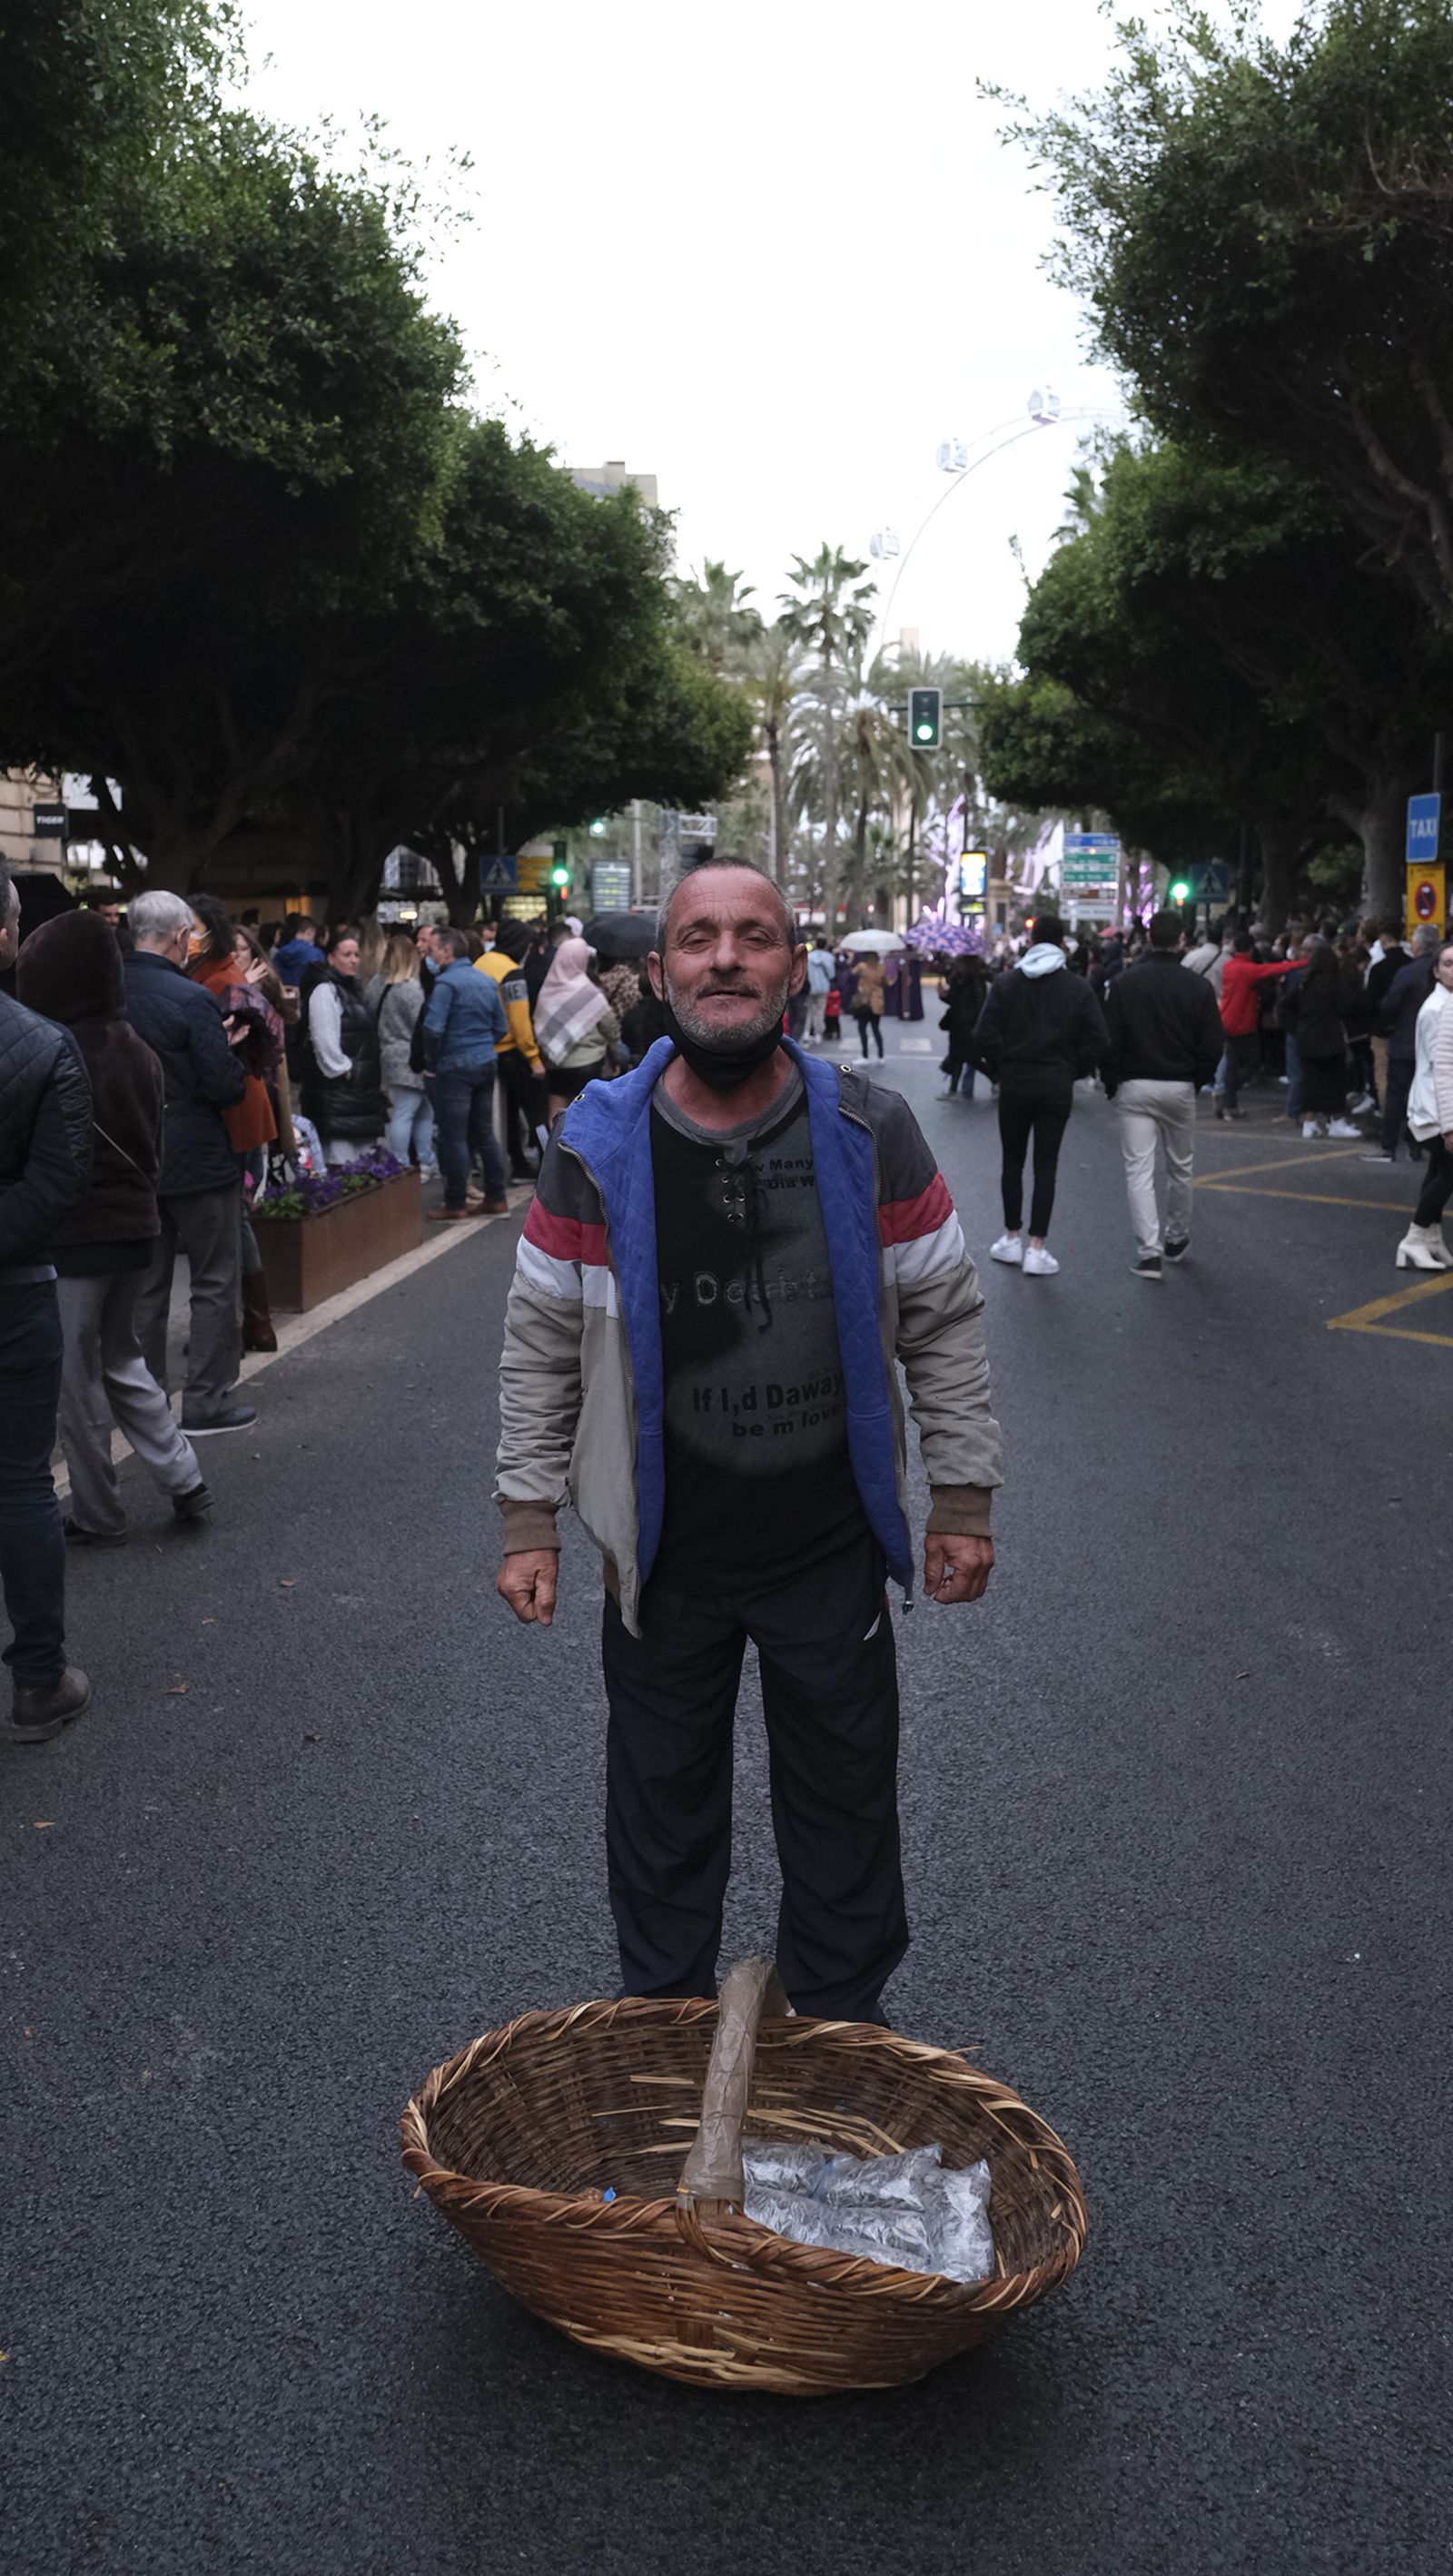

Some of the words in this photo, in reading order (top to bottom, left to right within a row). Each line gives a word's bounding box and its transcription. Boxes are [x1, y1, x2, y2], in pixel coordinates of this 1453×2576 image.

[36, 815, 64, 825] TIGER
[1410, 818, 1438, 838] TAXI
[769, 1158, 815, 1170] Many
[693, 1387, 712, 1413] If
[766, 1371, 843, 1409] Daway
[733, 1422, 765, 1436] be
[773, 1421, 795, 1436] m
